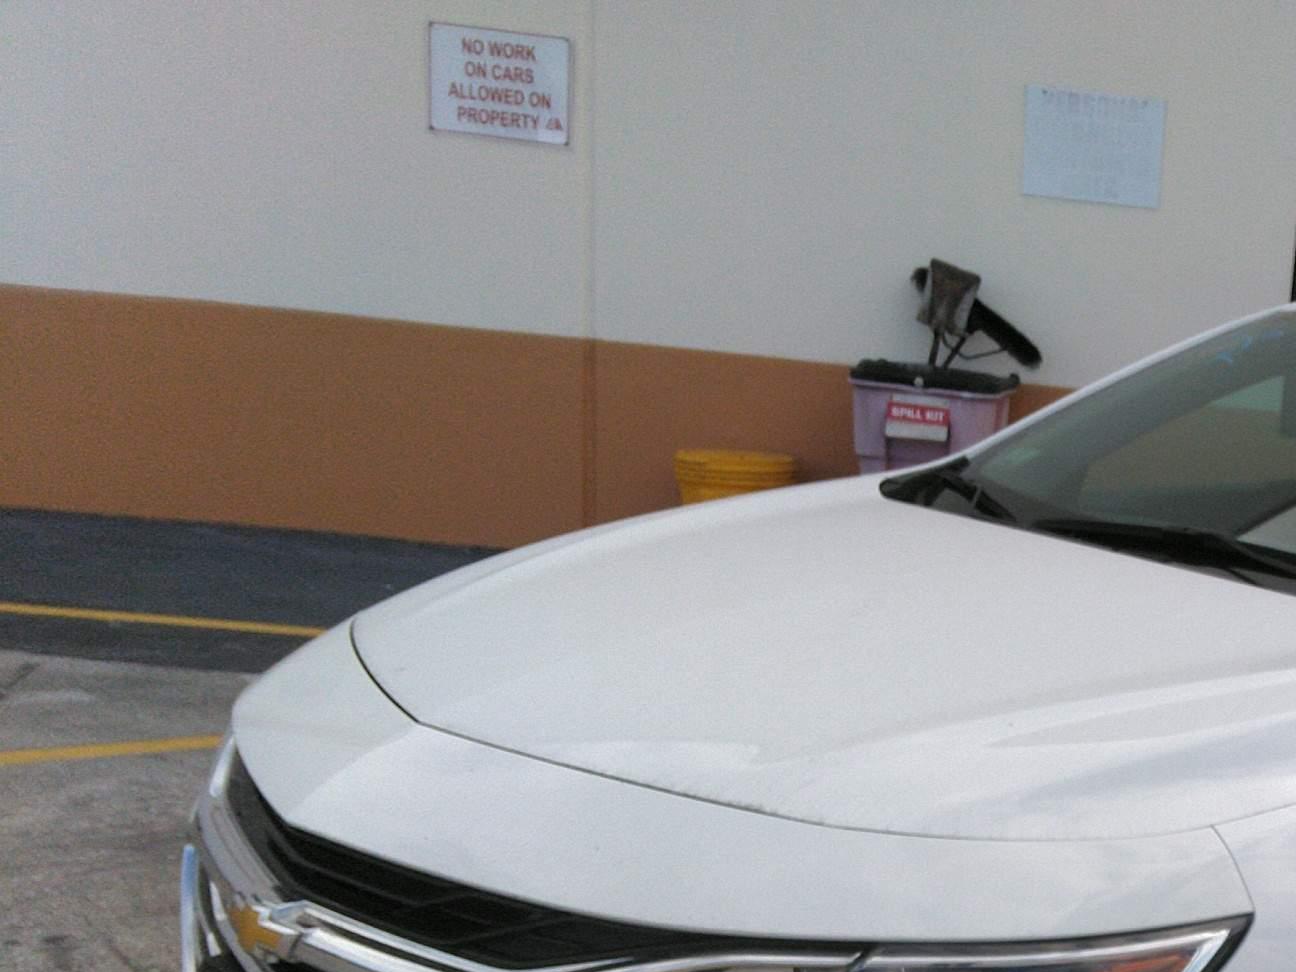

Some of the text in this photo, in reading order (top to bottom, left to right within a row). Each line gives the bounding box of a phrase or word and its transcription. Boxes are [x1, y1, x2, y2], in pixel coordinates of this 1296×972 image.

[461, 38, 536, 61] NO WORK
[464, 61, 535, 84] ON CARS
[448, 82, 552, 109] ALLOWED ON
[457, 106, 540, 130] PROPERTY
[925, 410, 945, 422] KIT
